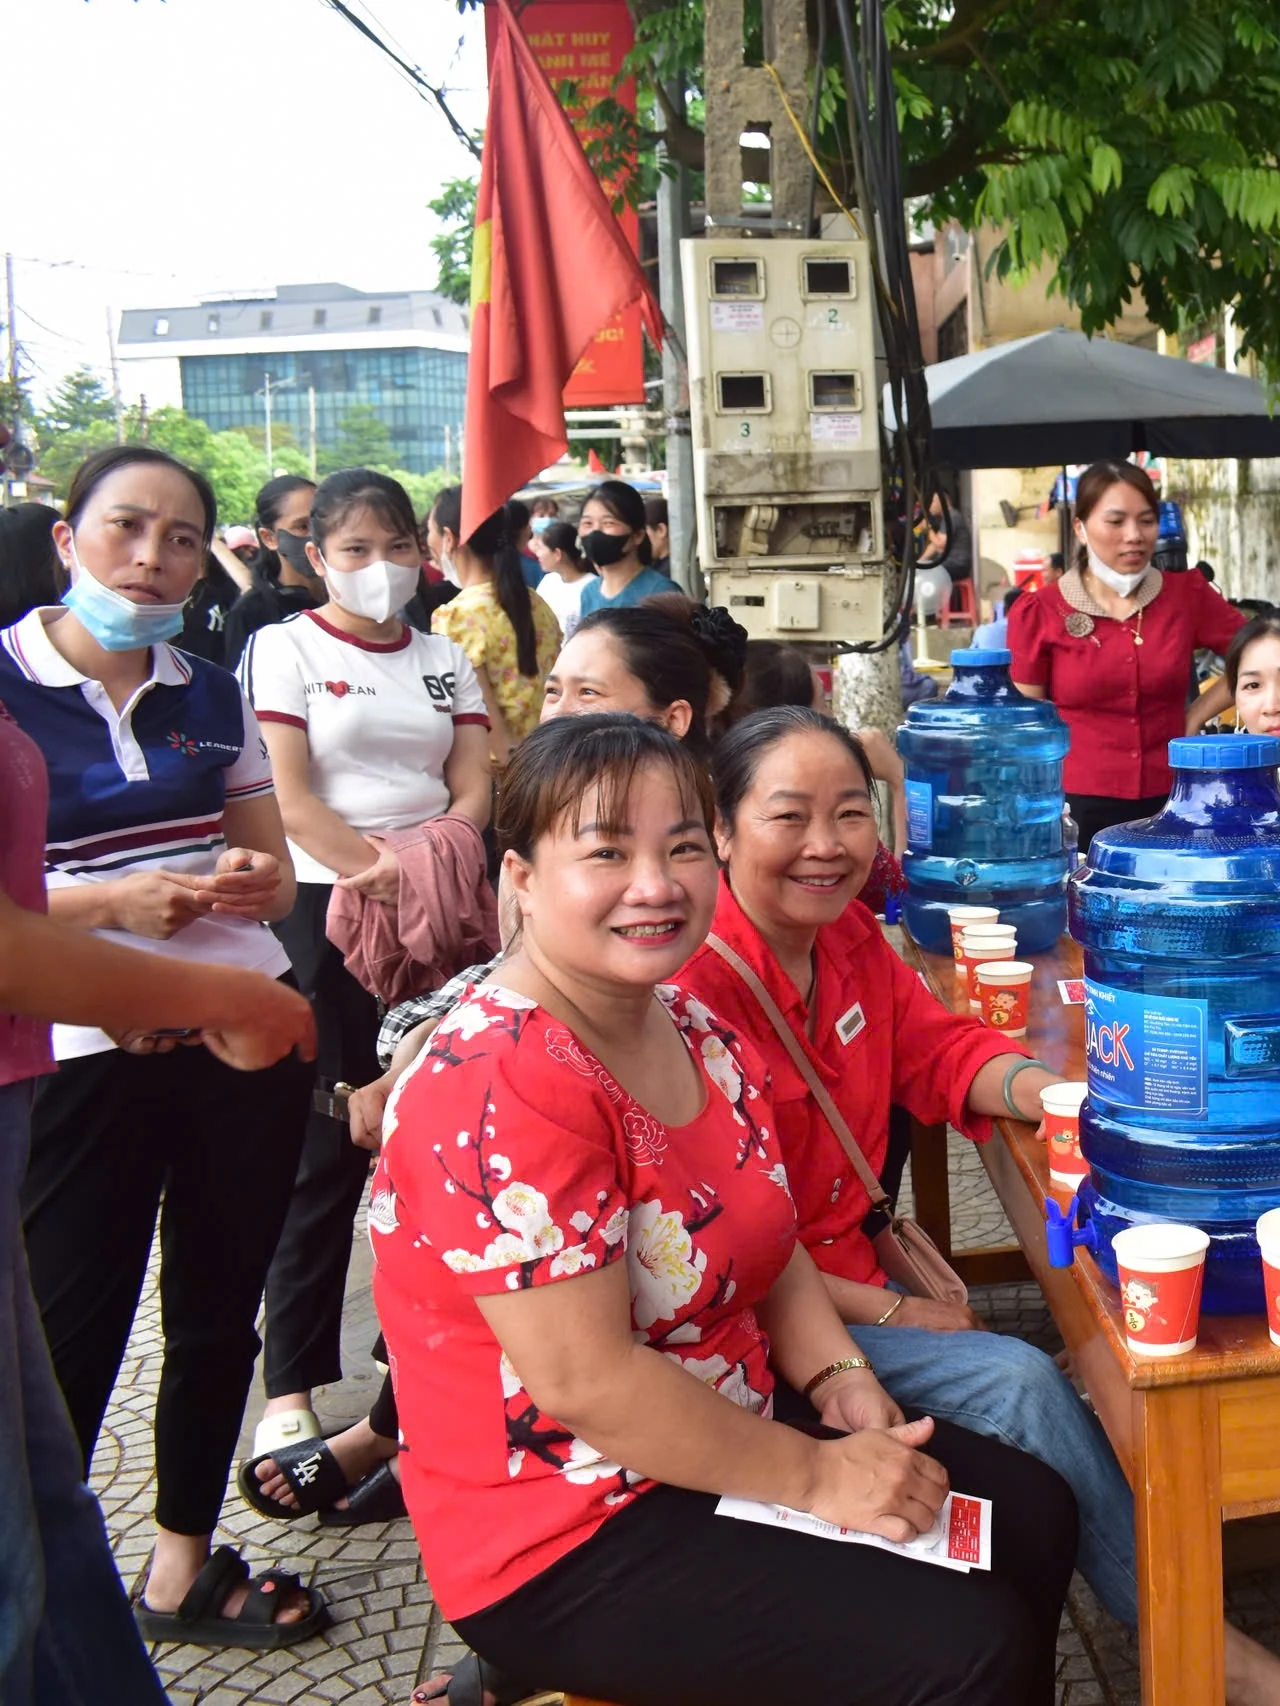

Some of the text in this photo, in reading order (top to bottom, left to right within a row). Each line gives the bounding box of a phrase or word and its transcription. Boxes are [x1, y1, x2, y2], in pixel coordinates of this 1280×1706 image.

[828, 308, 838, 323] 2
[740, 422, 751, 437] 3
[1098, 990, 1116, 1003] KHIẾT
